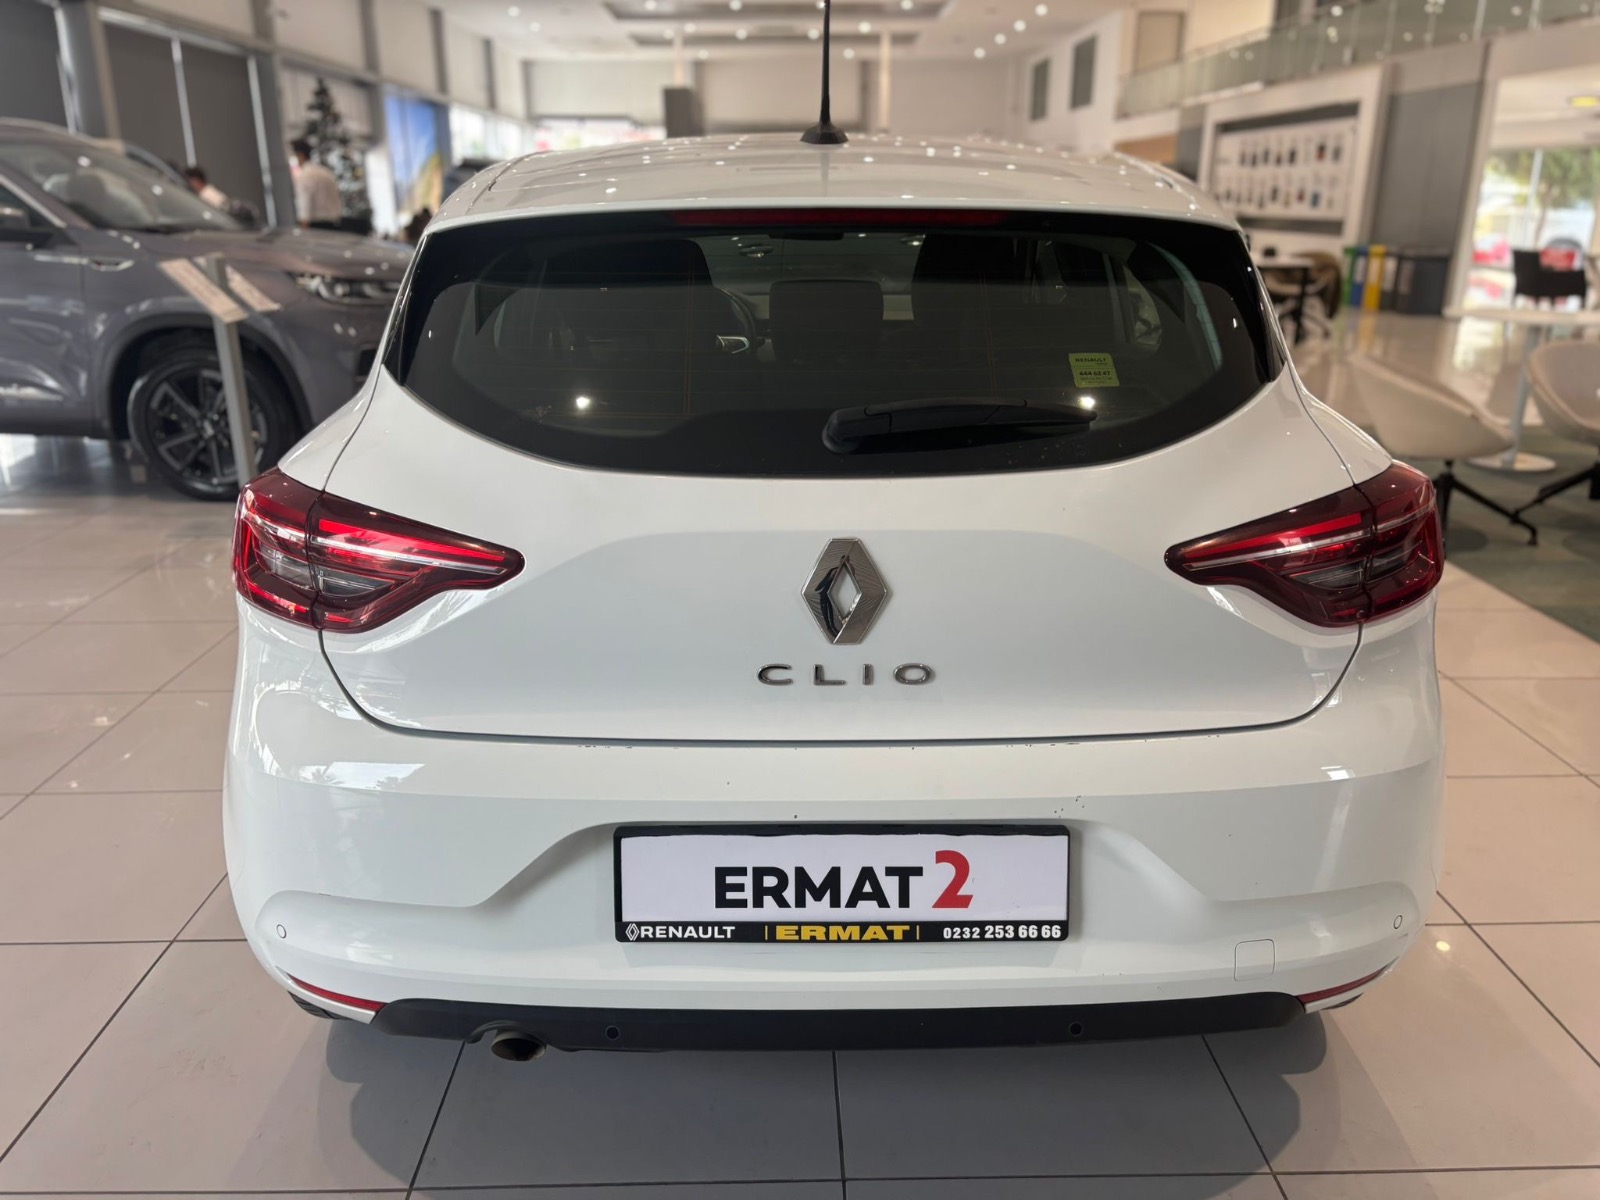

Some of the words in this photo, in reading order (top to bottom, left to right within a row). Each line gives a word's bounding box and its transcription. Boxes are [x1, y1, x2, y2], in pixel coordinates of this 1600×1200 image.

[757, 663, 935, 686] CLIO
[714, 866, 923, 909] ERMAT
[931, 849, 974, 909] 2
[640, 925, 736, 939] RENAULT
[775, 925, 910, 941] ERMAT
[943, 927, 980, 939] 0232
[984, 925, 1015, 939] 253
[1018, 925, 1038, 939] 66
[1041, 925, 1061, 939] 66
